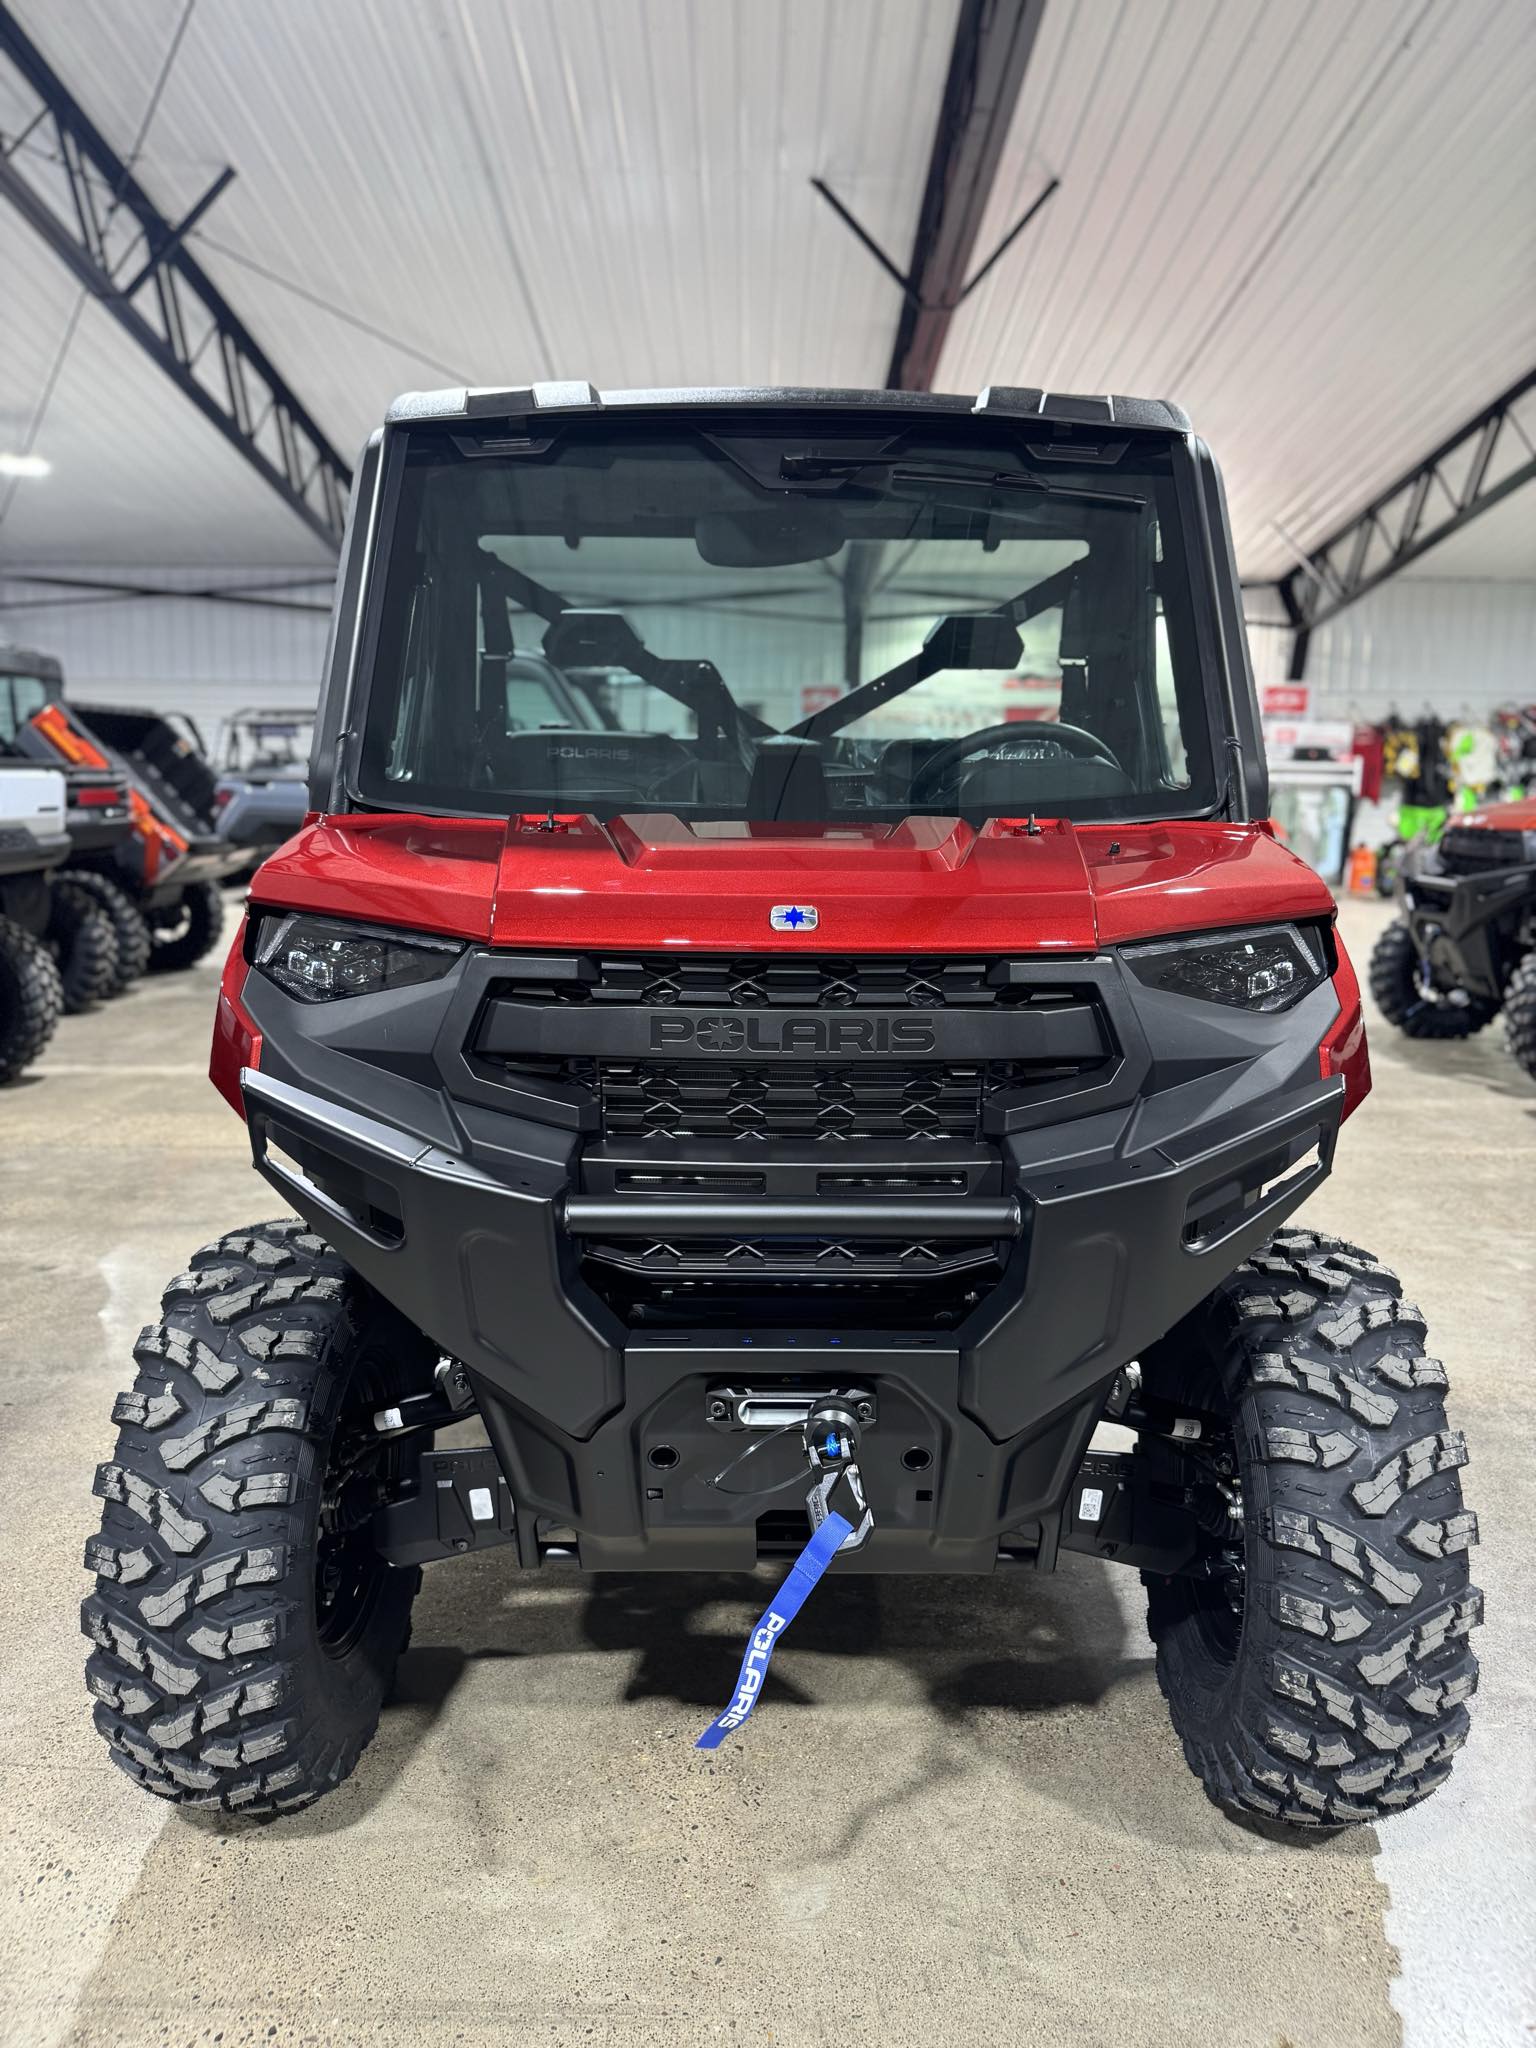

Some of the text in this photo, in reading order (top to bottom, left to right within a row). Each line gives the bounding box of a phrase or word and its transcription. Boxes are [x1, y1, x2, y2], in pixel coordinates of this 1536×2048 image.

[546, 747, 631, 761] POLARIS
[649, 1015, 937, 1054] POLARIS
[717, 1611, 786, 1729] POLARIS
